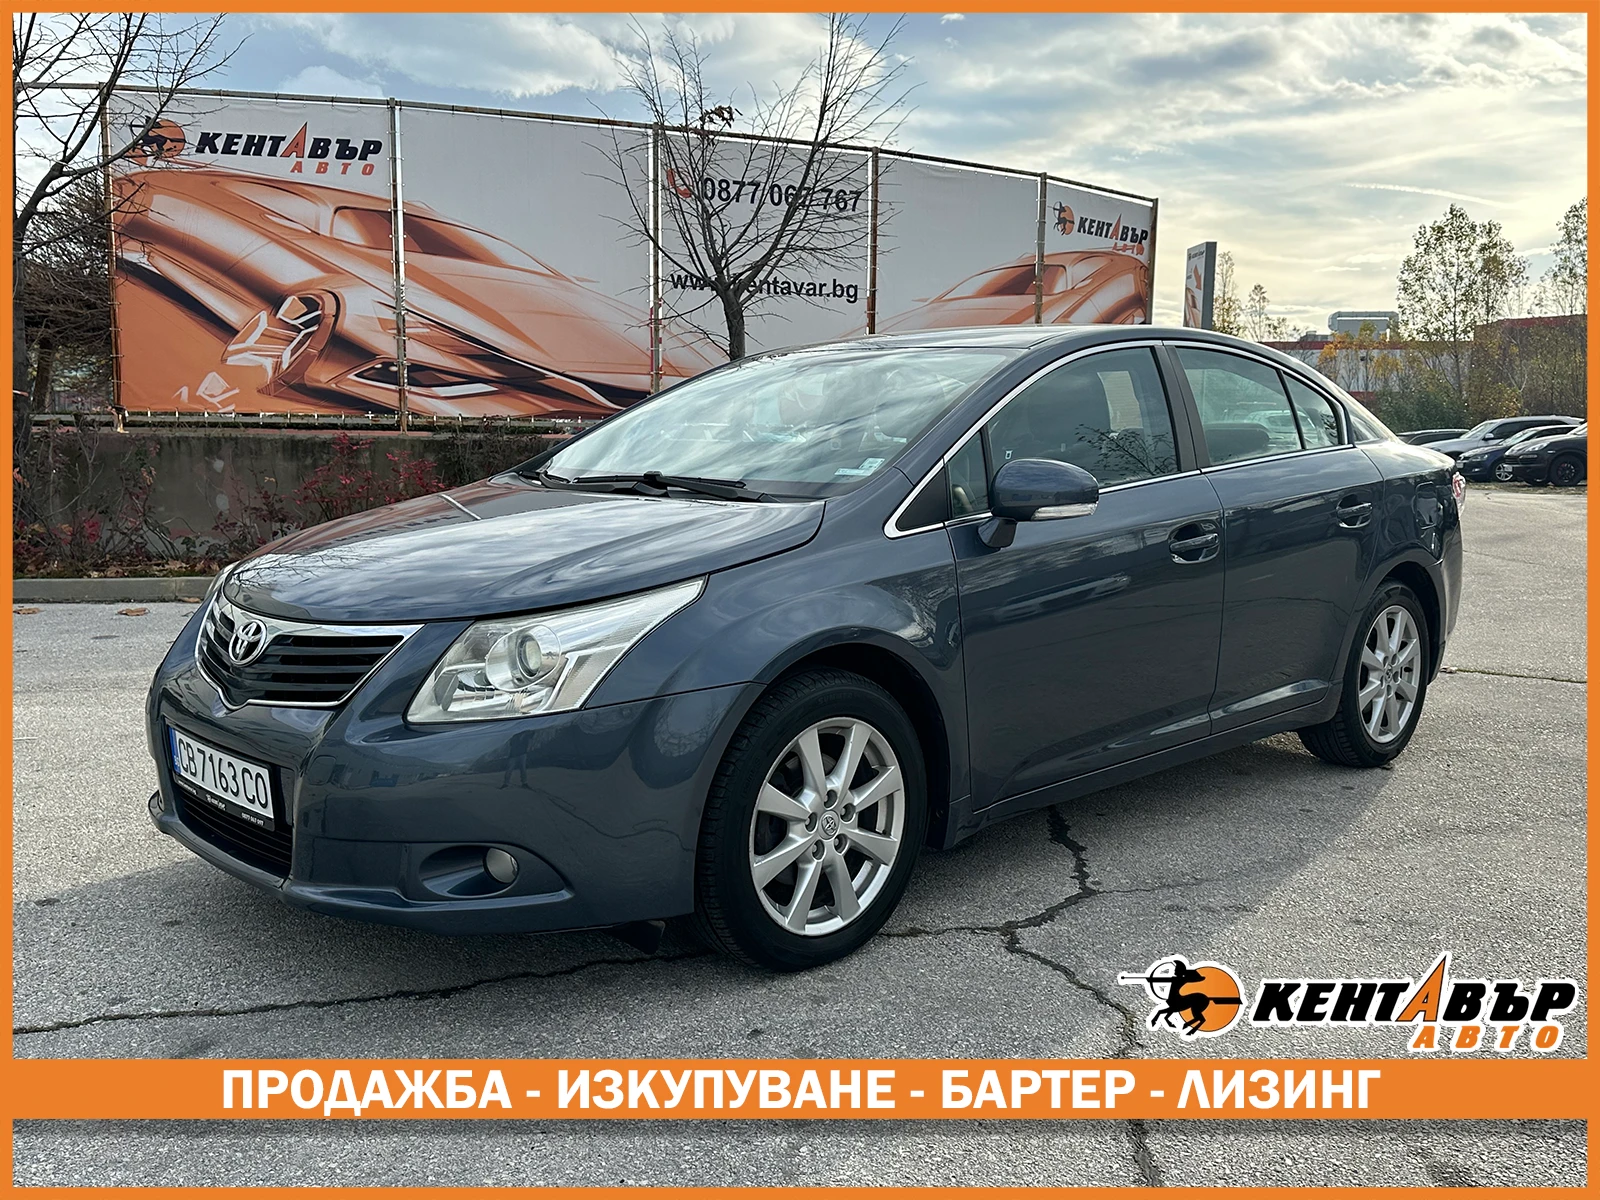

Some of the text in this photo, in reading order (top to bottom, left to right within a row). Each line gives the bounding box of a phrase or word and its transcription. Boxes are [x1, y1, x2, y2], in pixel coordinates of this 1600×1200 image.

[195, 121, 382, 161] КЕНТАВЪР
[290, 160, 375, 176] АВТО
[702, 177, 761, 204] 0877
[820, 187, 863, 213] 767
[1077, 213, 1149, 244] КЕНТАВЪР
[670, 273, 859, 304] wwentavar.bg
